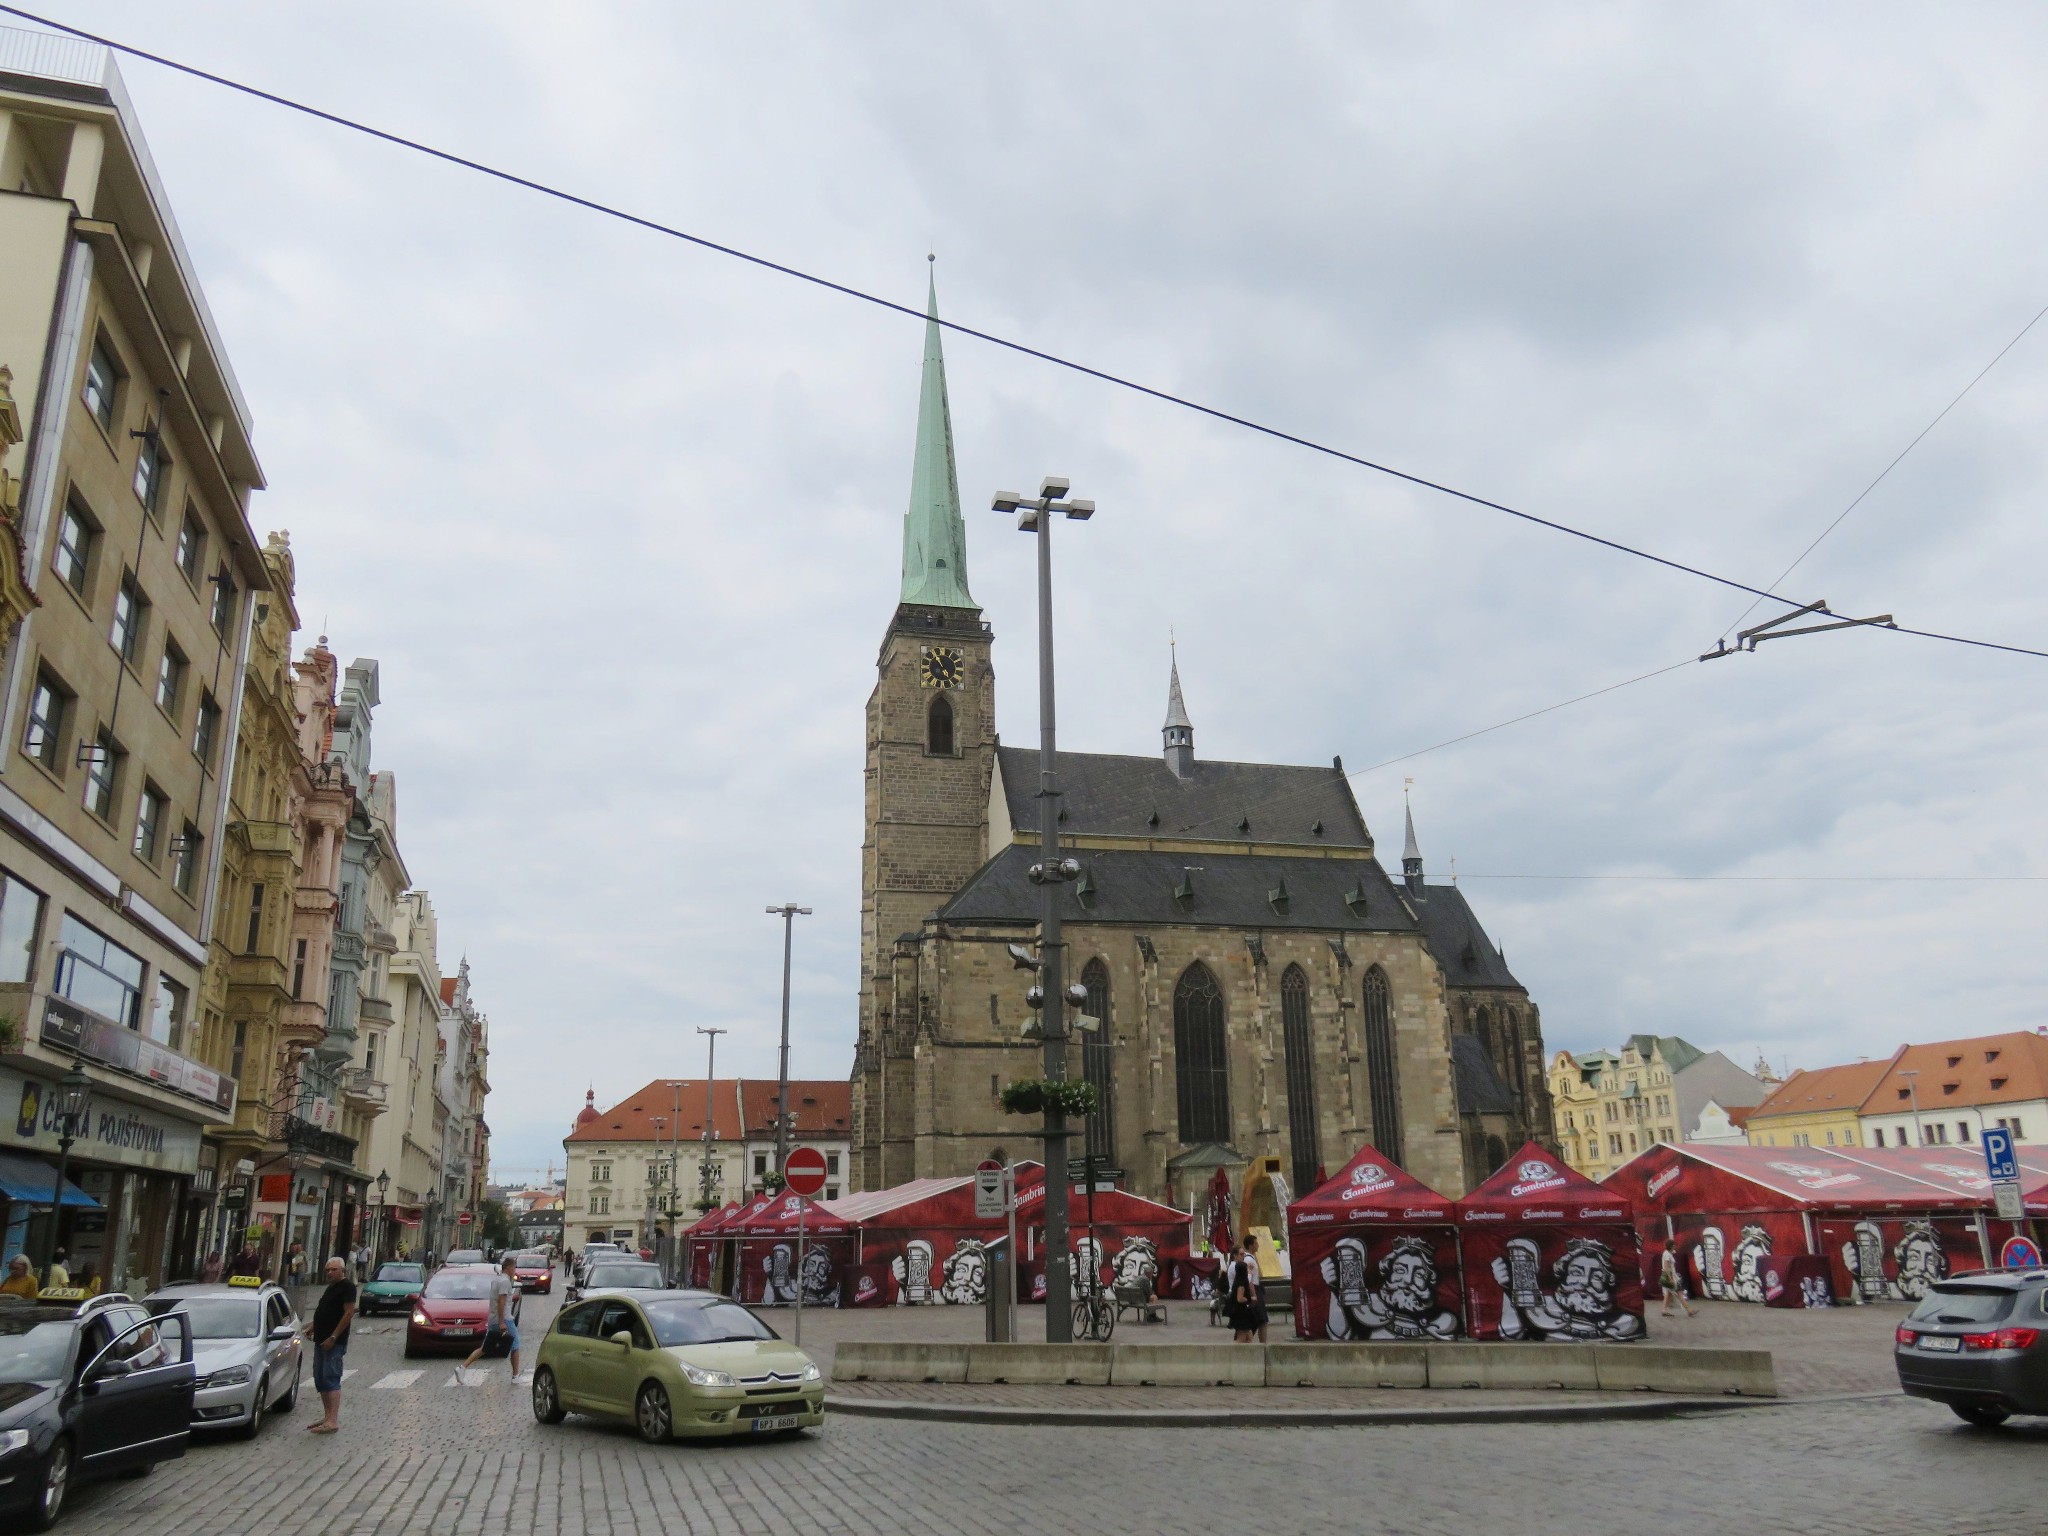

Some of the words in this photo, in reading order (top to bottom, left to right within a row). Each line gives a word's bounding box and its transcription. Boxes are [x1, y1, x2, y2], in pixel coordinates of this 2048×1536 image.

[97, 1112, 164, 1153] POJIŠŤOVNA
[1987, 1135, 2006, 1165] P
[1341, 1179, 1395, 1201] Gambrinus
[1511, 1177, 1566, 1197] Gambrinus
[1295, 1212, 1335, 1224] Gambrinus
[1349, 1208, 1389, 1220] Gambrinus
[1403, 1207, 1444, 1219] Gambrinus
[1464, 1210, 1506, 1221] Gambrinus
[1521, 1208, 1564, 1220] Gambrinus
[1579, 1207, 1623, 1219] Gambrinus
[45, 1287, 82, 1297] TAXI
